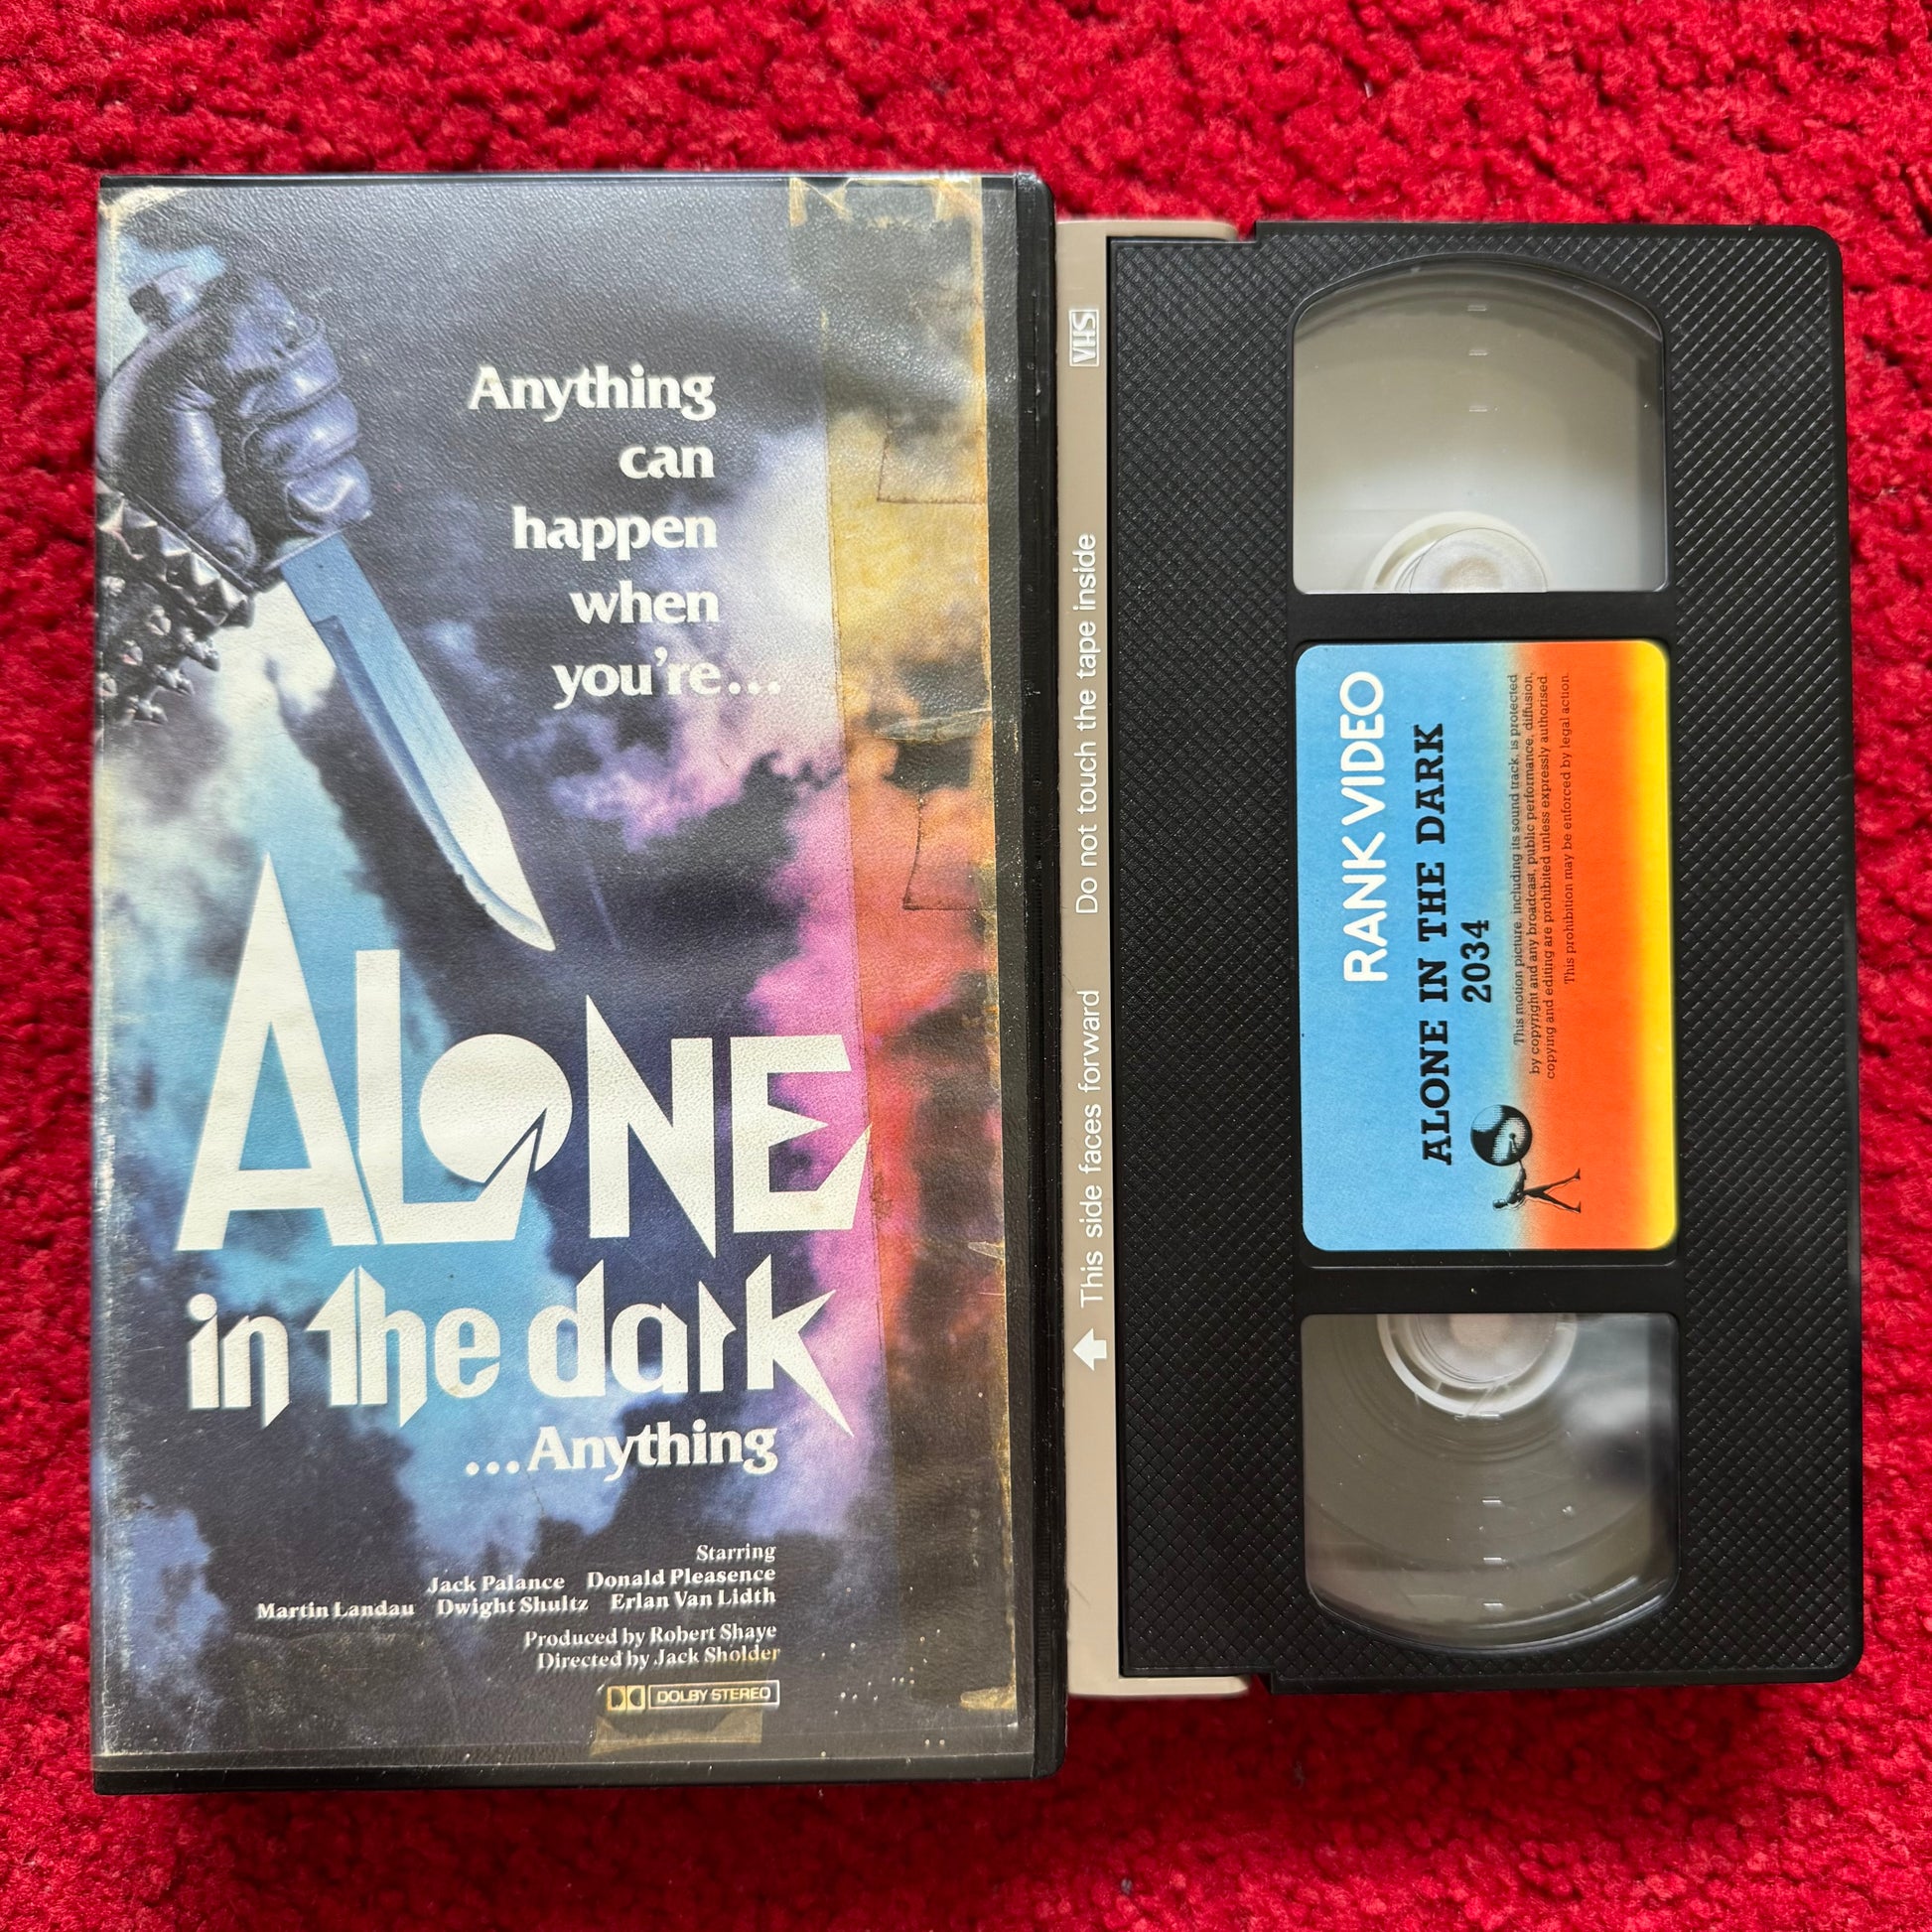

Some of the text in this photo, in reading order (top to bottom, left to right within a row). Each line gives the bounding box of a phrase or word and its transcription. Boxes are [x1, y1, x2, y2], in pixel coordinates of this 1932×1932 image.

[1071, 311, 1097, 365] VHS
[468, 362, 717, 422] Anything
[620, 445, 716, 480] can
[512, 506, 719, 561] happen
[569, 580, 721, 624] when
[1072, 533, 1103, 914] Do not touch the tape inside
[1507, 675, 1521, 736] protected
[1508, 740, 1520, 751] is
[1559, 717, 1572, 749] legal
[1538, 747, 1552, 808] expressly
[1560, 752, 1573, 768] by
[1508, 793, 1520, 832] sound
[1560, 772, 1572, 830] enforced
[1339, 670, 1388, 983] RANK VIDEO
[1509, 836, 1521, 850] its
[1539, 811, 1551, 852] unless
[1561, 834, 1573, 850] be
[1510, 854, 1523, 914] including
[1521, 672, 1542, 1074] by copyright and any broadcast, public performance, diffusion,
[1540, 856, 1554, 923] prohibited
[1563, 854, 1575, 880] may
[1542, 926, 1553, 947] are
[1562, 884, 1577, 954] prohibition
[1414, 722, 1452, 1167] ALONE IN THE DARK
[1460, 919, 1492, 1005] 2034
[1512, 918, 1524, 967] picture,
[1512, 970, 1524, 1015] motion
[1542, 951, 1555, 996] editing
[1563, 957, 1575, 985] This
[1512, 1018, 1524, 1045] This
[1543, 999, 1555, 1024] and
[175, 851, 873, 1258] ALONE
[1544, 1027, 1557, 1079] copying
[1075, 990, 1104, 1310] This side faces forward
[188, 1253, 855, 1438] in the dark
[696, 1543, 776, 1563] Starring
[427, 1567, 776, 1593] Jack Palance Donald Pleasence
[255, 1587, 777, 1619] Martin Landau Dwight Shultz Erlan Van Lidth
[524, 1623, 777, 1648] Produced by Robert Shaye
[537, 1644, 781, 1670] Directed by Jack Sholder
[656, 1686, 771, 1704] DOLBY STEREO
